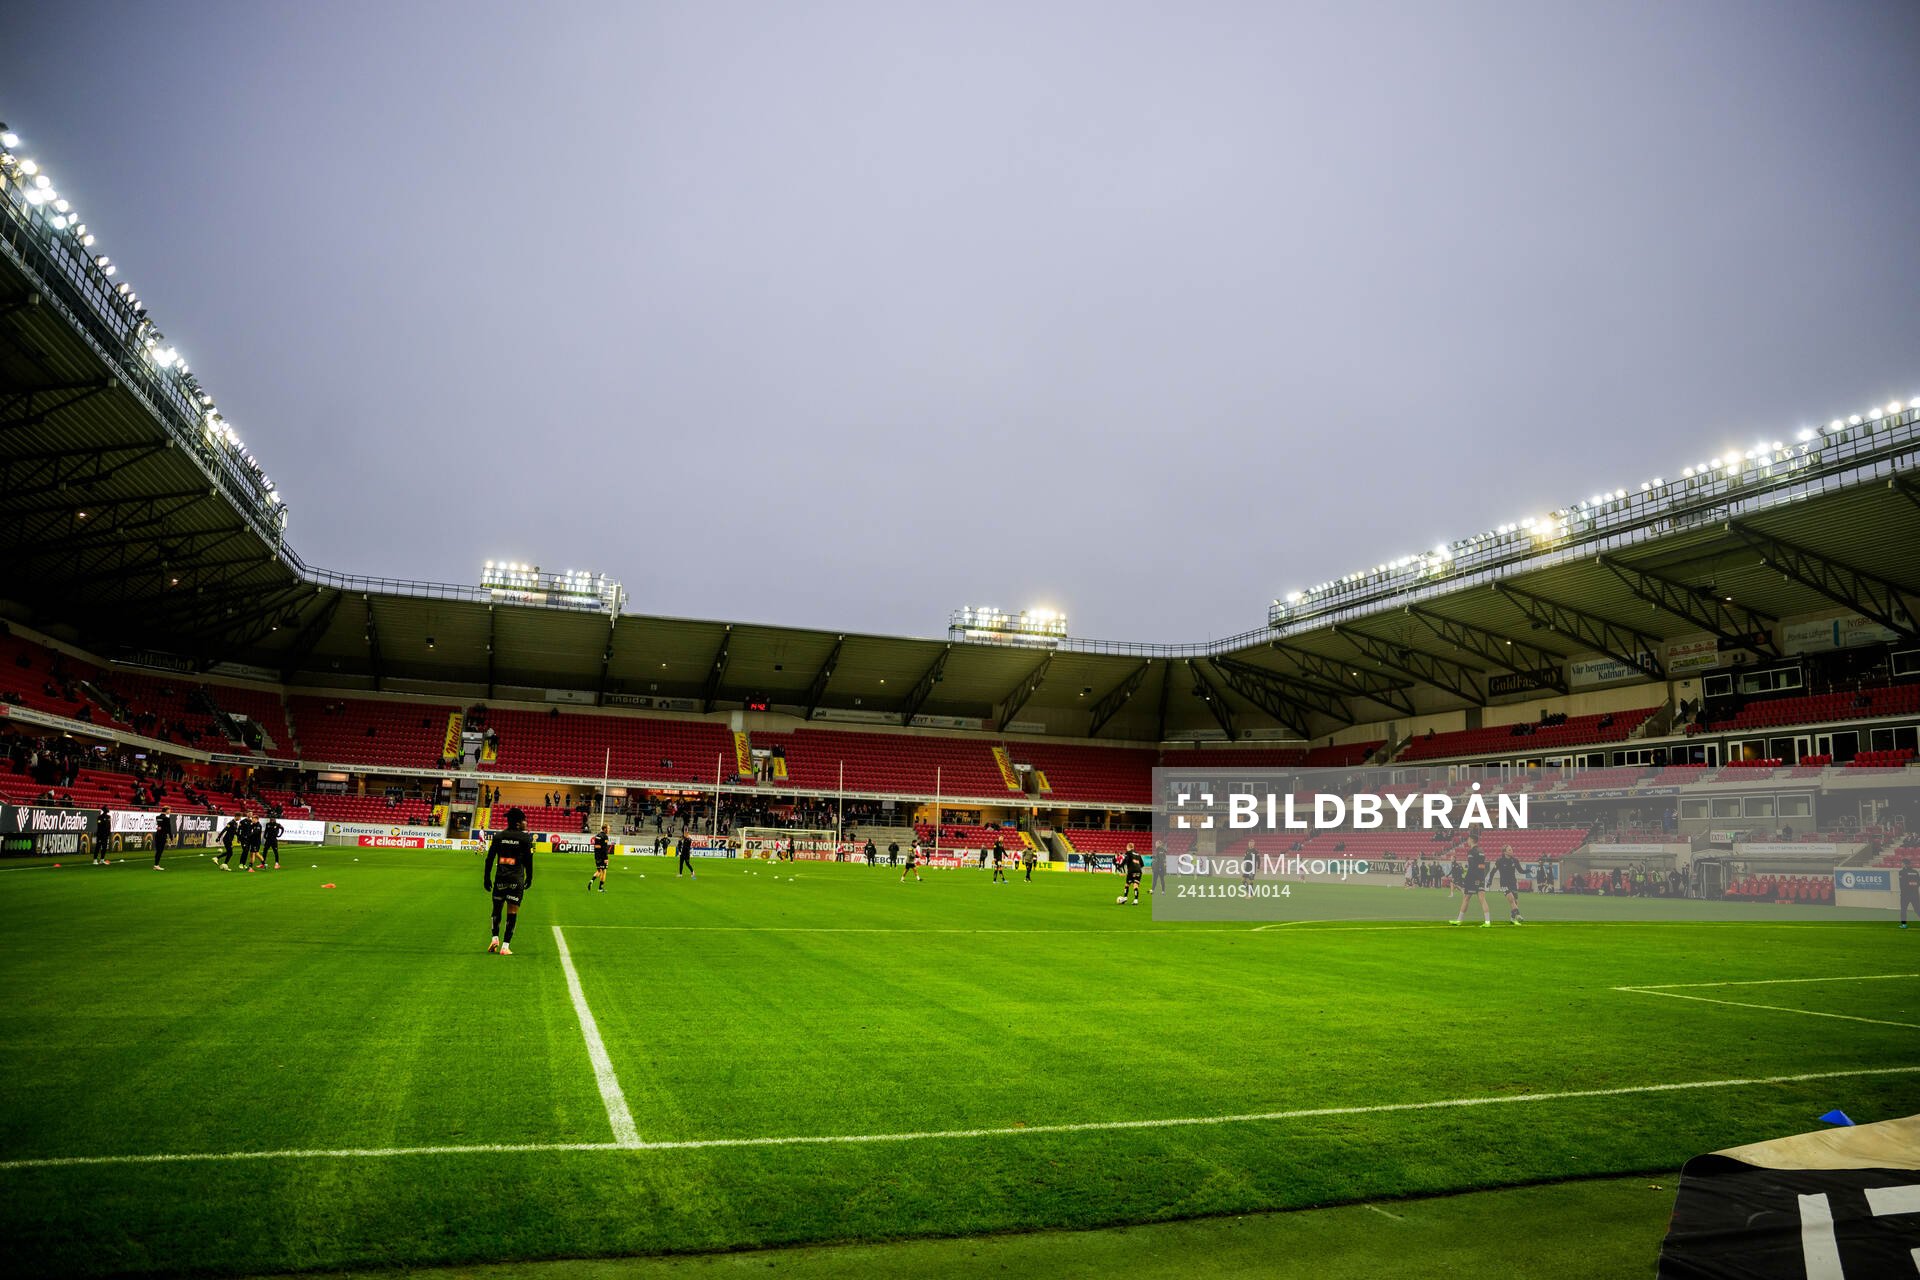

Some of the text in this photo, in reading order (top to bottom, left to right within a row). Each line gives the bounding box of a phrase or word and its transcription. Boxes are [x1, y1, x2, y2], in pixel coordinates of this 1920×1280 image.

[32, 810, 87, 831] Wilson Creative
[343, 826, 442, 837] infoservice infoservice
[376, 837, 417, 848] elkedjan
[559, 844, 595, 852] OPTIME
[795, 850, 820, 860] renta
